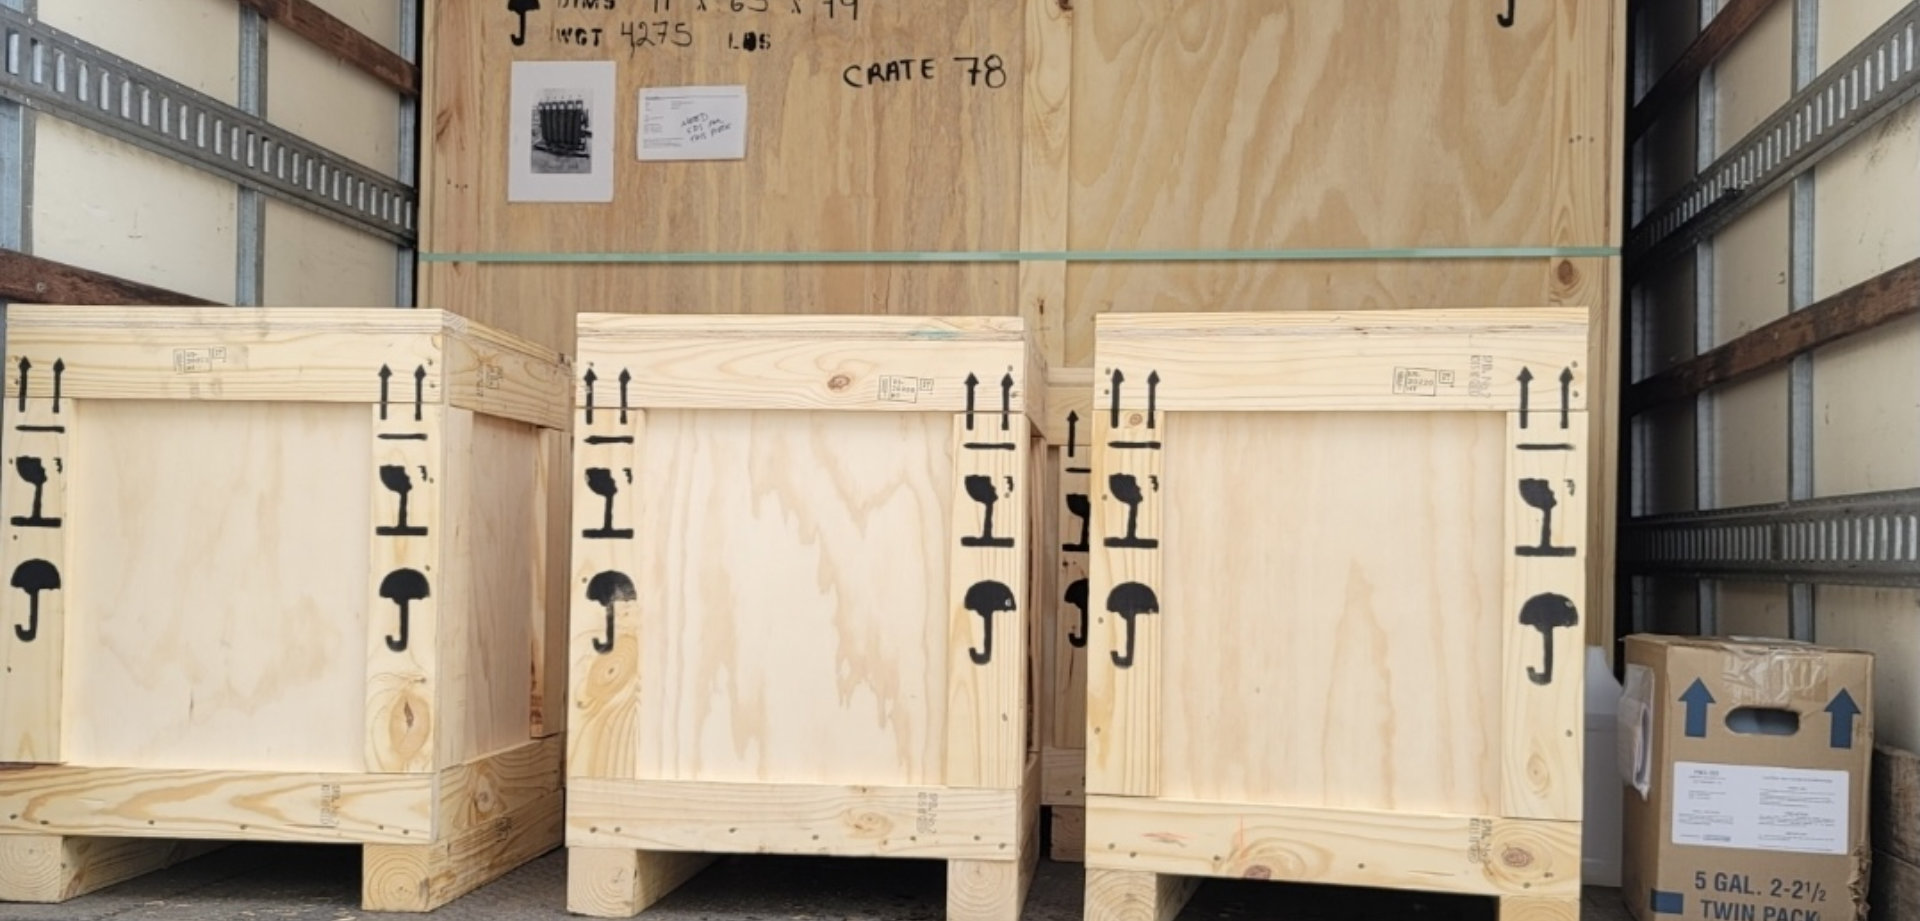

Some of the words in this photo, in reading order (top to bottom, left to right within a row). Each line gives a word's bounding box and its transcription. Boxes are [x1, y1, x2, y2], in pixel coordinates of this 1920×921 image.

[556, 28, 603, 47] WGT
[620, 20, 693, 59] 4275
[842, 57, 936, 89] CRATE
[952, 53, 1007, 89] 78
[1694, 871, 1707, 890] 5
[1714, 871, 1762, 896] GAL.
[1701, 899, 1755, 921] TWIN
[1763, 906, 1820, 921] PACK
